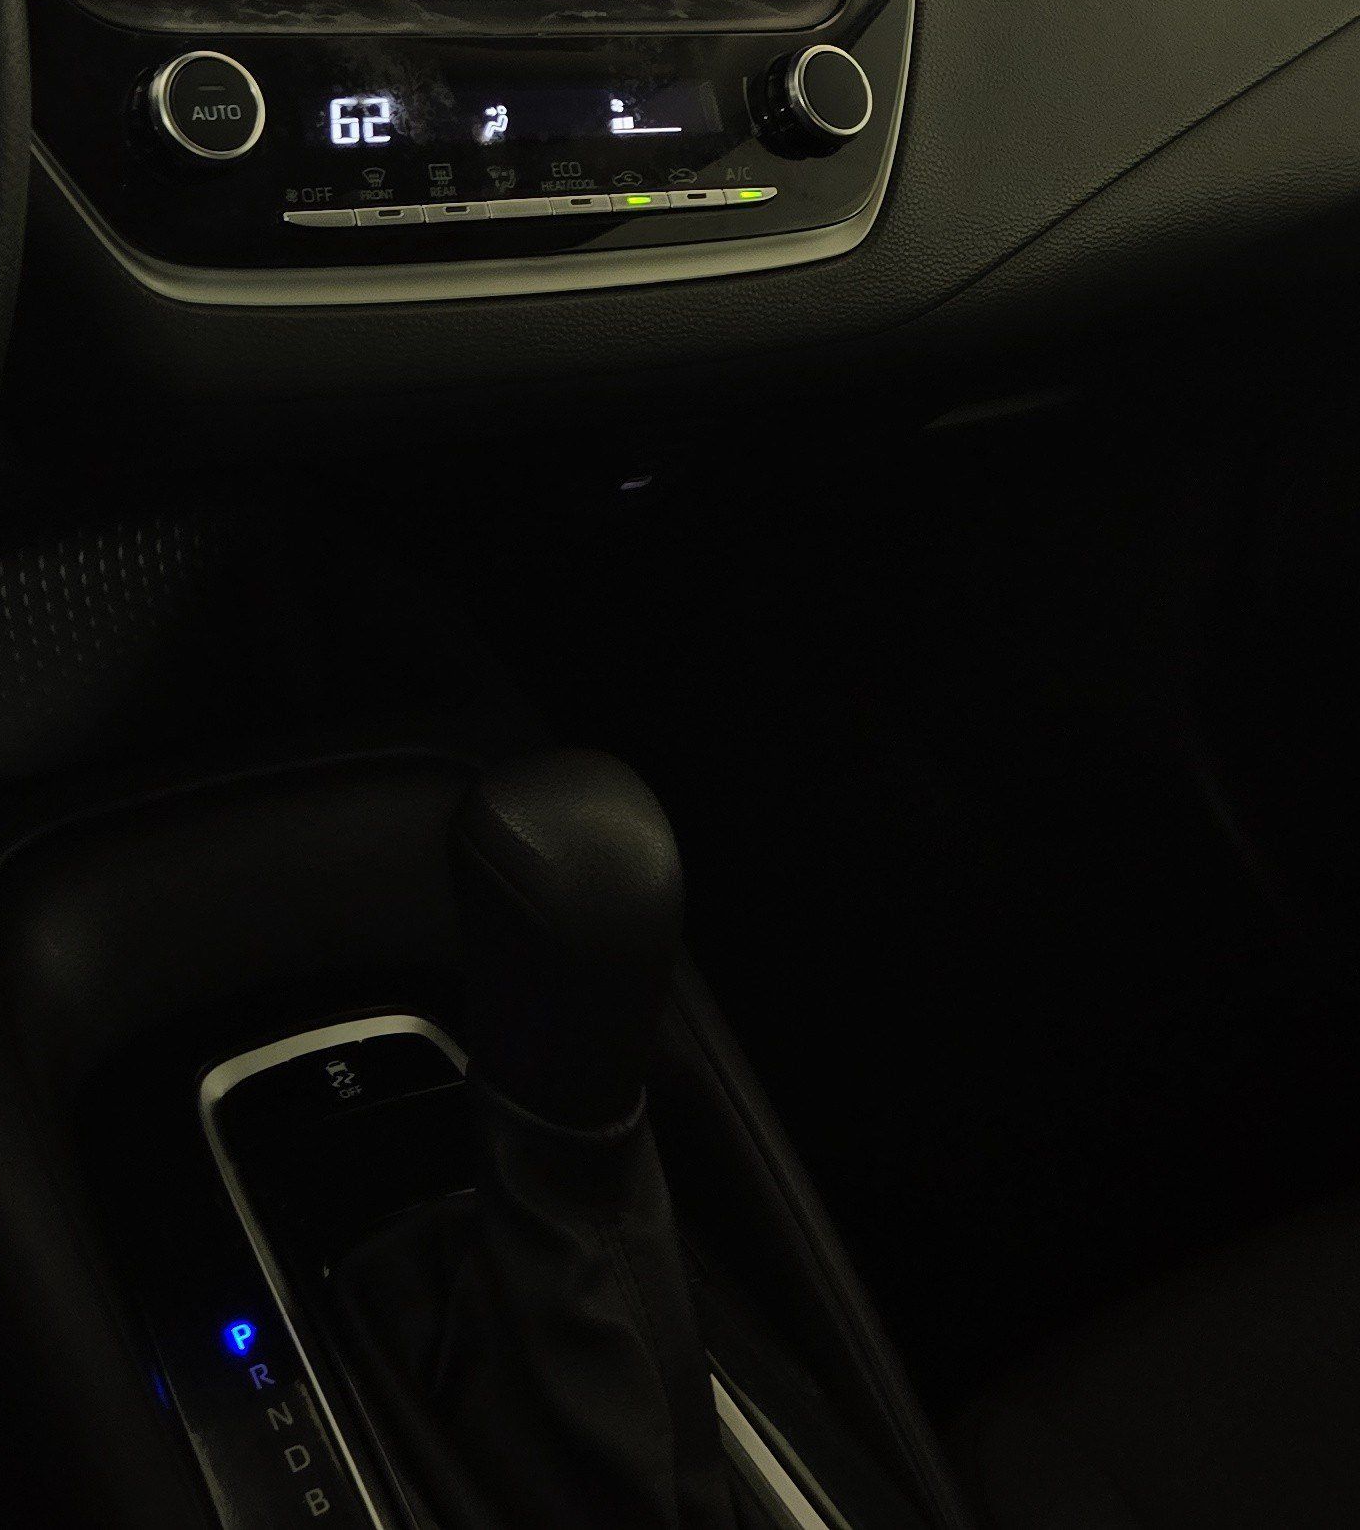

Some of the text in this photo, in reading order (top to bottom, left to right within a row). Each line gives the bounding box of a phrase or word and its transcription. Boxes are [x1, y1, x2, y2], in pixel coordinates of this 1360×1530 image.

[192, 104, 242, 121] AUTO
[330, 97, 392, 144] 62
[551, 161, 582, 178] ECO
[725, 167, 753, 181] A/C
[429, 185, 458, 197] REAR
[541, 179, 597, 192] HEAT/COOL
[301, 187, 333, 203] OFF
[359, 188, 394, 201] FRONT
[338, 1084, 363, 1099] OFF
[231, 1323, 251, 1349] P
[249, 1362, 275, 1389] R
[266, 1401, 293, 1431] N
[285, 1444, 310, 1472] D
[305, 1487, 330, 1517] B
